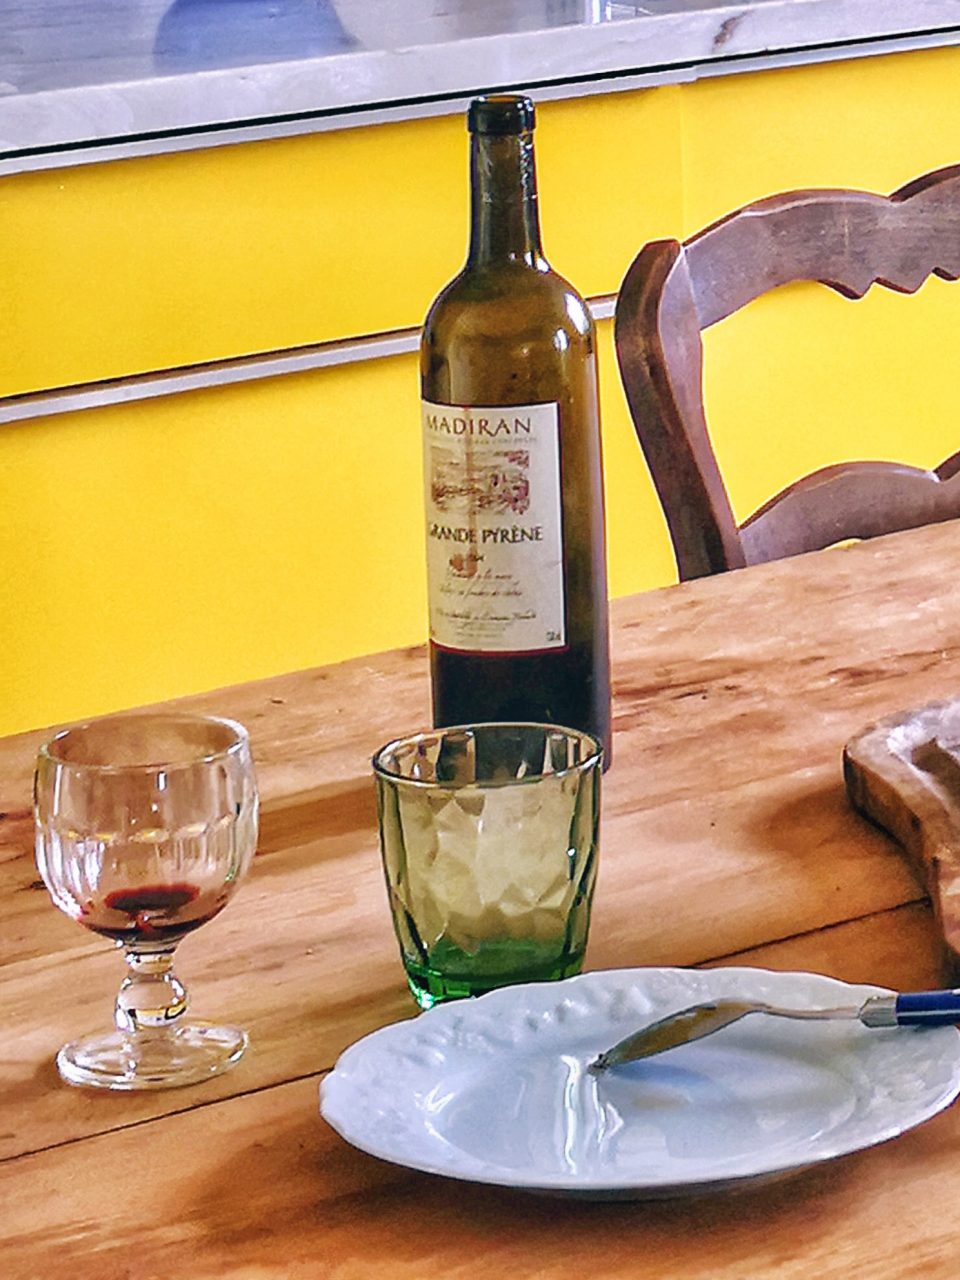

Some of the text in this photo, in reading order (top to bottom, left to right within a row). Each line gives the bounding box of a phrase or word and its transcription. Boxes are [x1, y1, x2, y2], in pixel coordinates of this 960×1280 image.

[427, 414, 531, 437] MADIRAN
[429, 523, 544, 544] RANDE PYRÈNE
